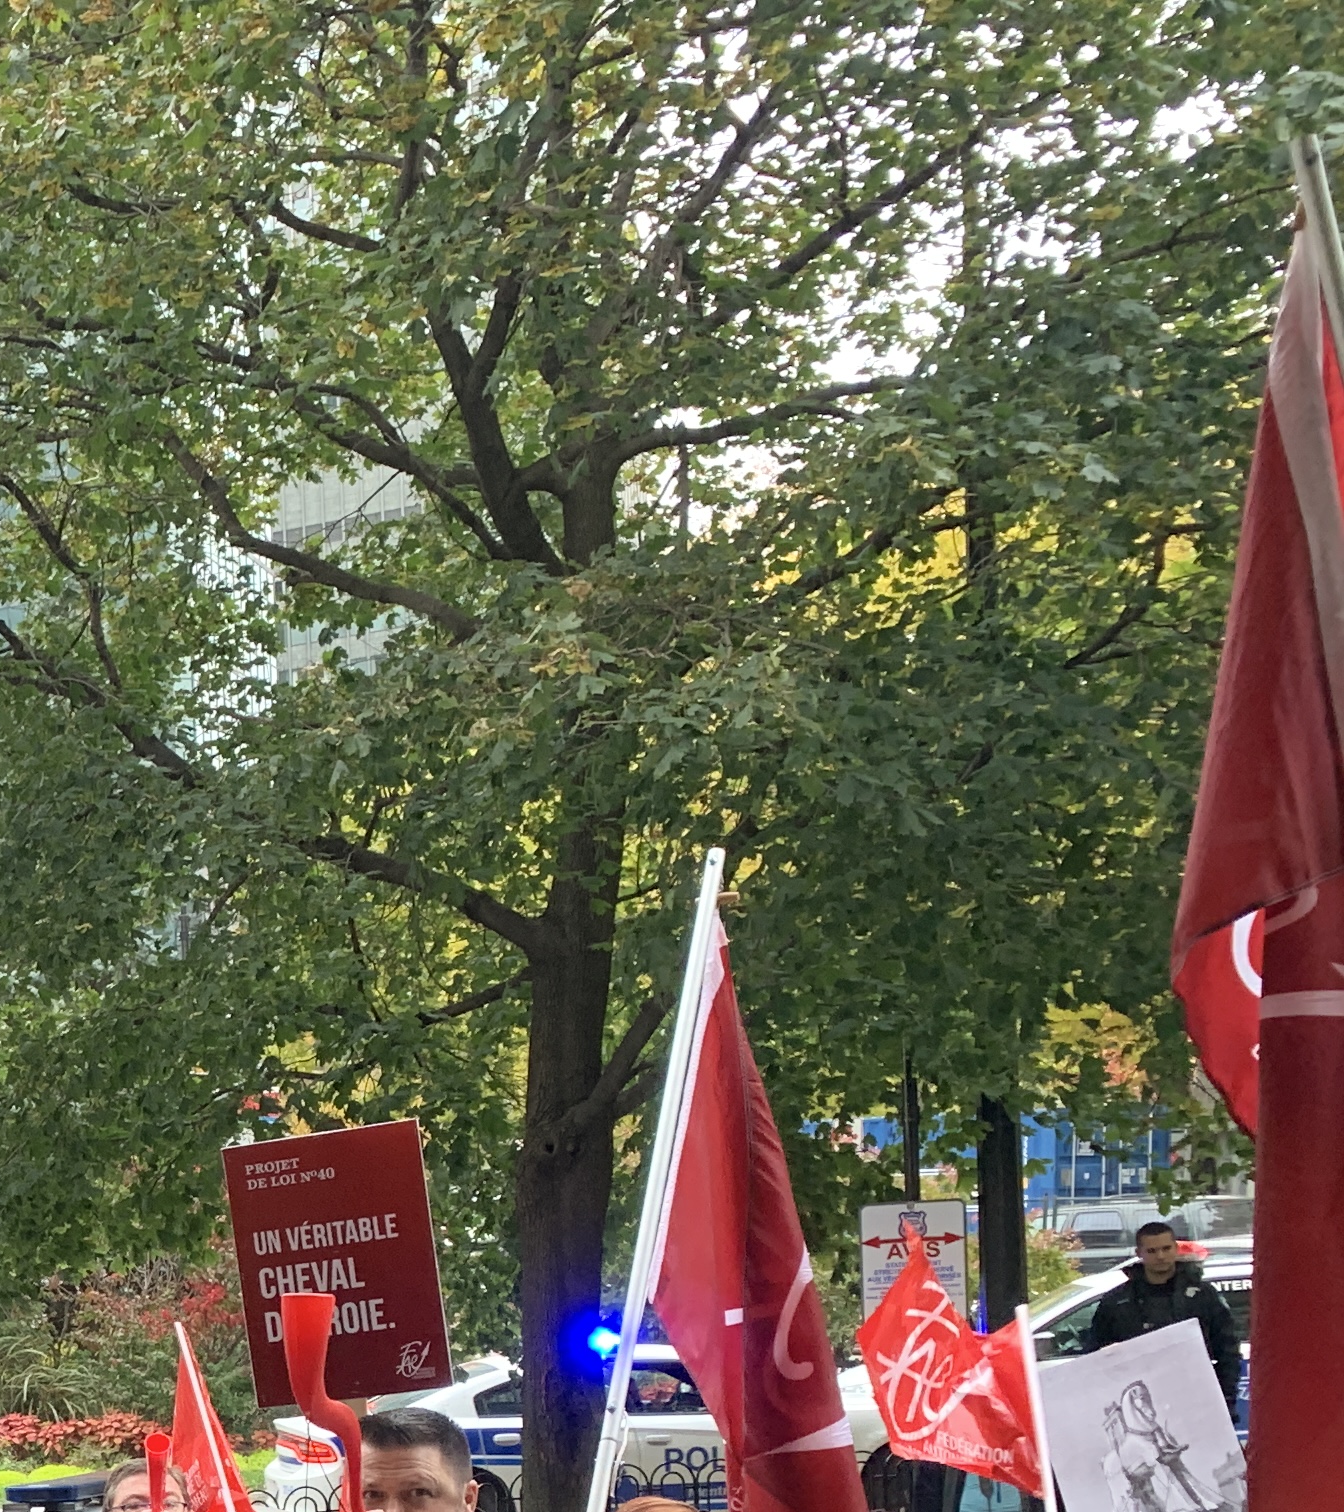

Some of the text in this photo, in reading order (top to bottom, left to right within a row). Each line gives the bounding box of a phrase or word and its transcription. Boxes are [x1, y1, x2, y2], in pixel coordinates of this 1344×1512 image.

[245, 1157, 300, 1176] PROJET
[247, 1177, 268, 1191] DE
[271, 1172, 298, 1188] LOI
[253, 1213, 399, 1256] UN VÉRITABLE
[258, 1257, 365, 1299] CHEVAL
[264, 1298, 396, 1343] D ROIE.
